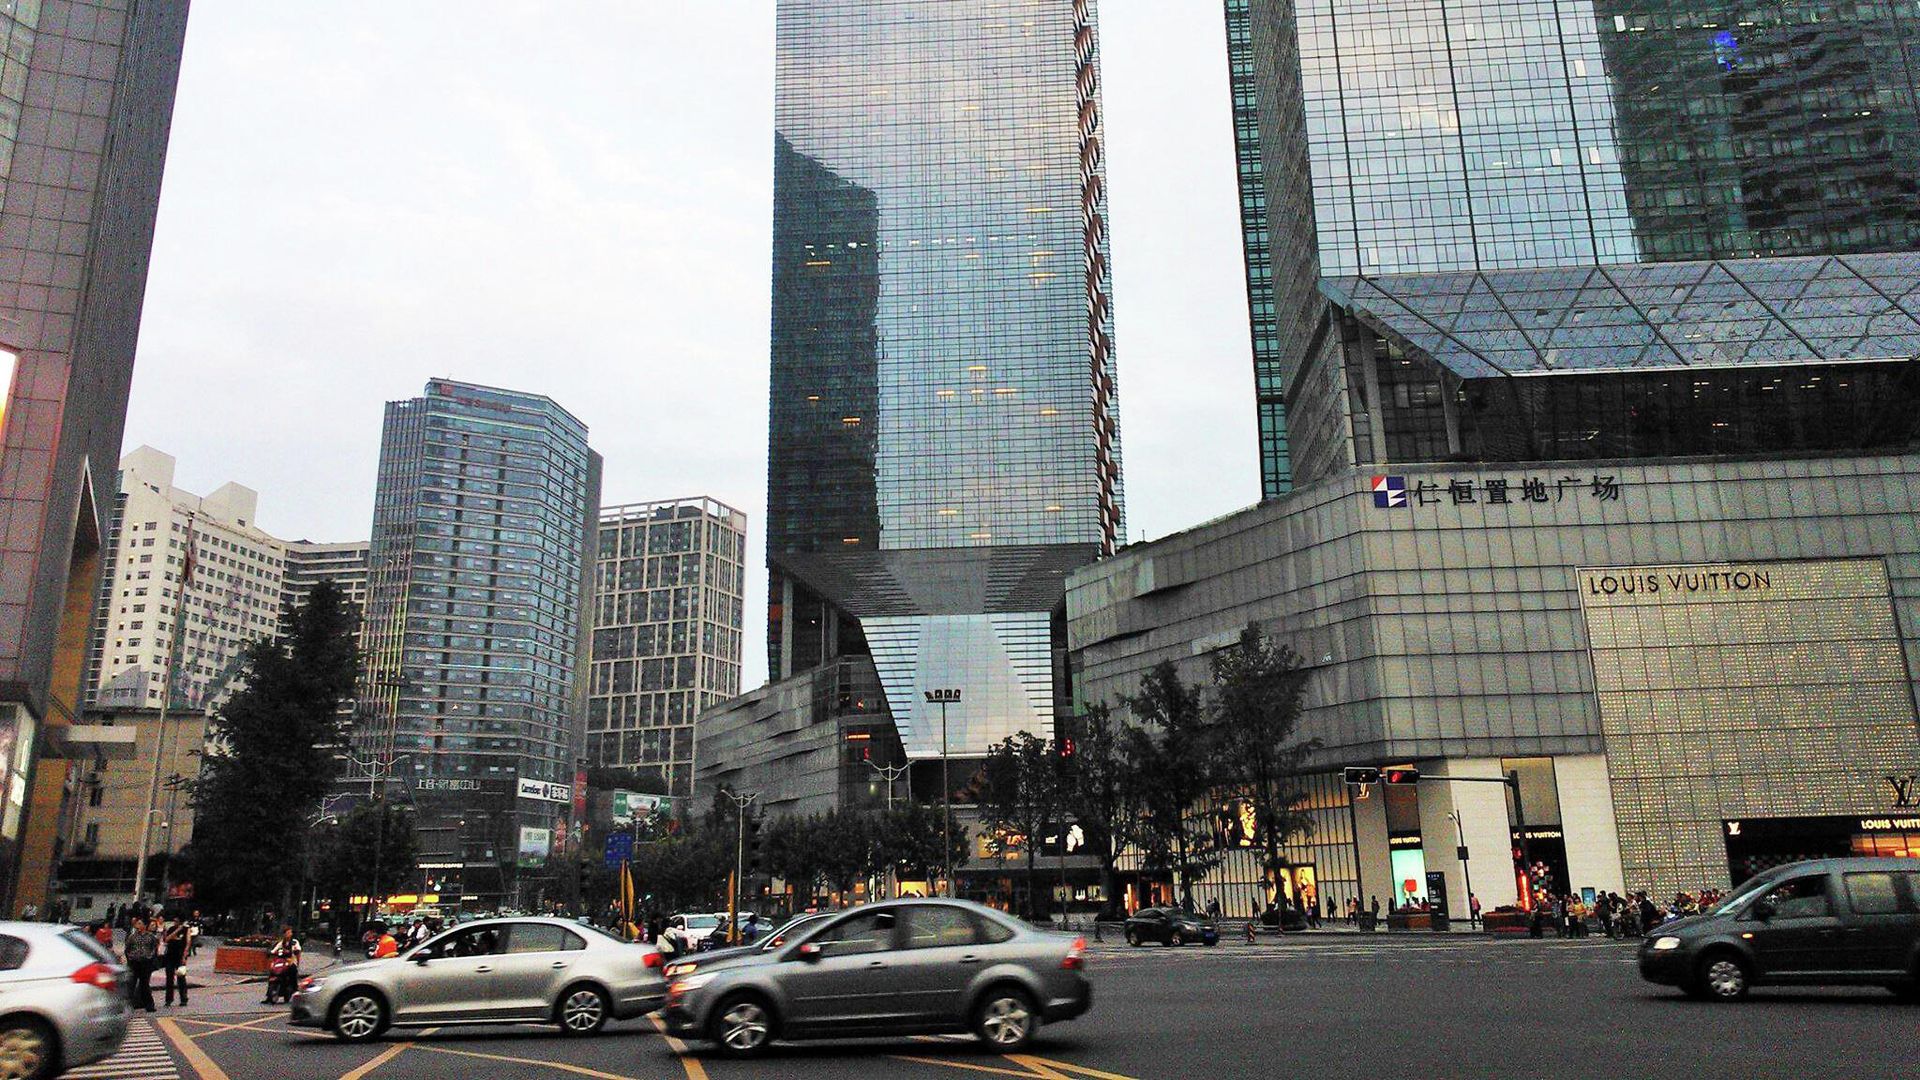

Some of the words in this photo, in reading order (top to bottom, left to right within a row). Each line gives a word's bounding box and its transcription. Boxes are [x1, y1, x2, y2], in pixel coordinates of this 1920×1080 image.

[1413, 475, 1620, 508] 仁恒置地广场
[1590, 575, 1659, 594] LOUIS
[1667, 571, 1772, 591] VUITTON
[1861, 820, 1892, 829] LOUIS
